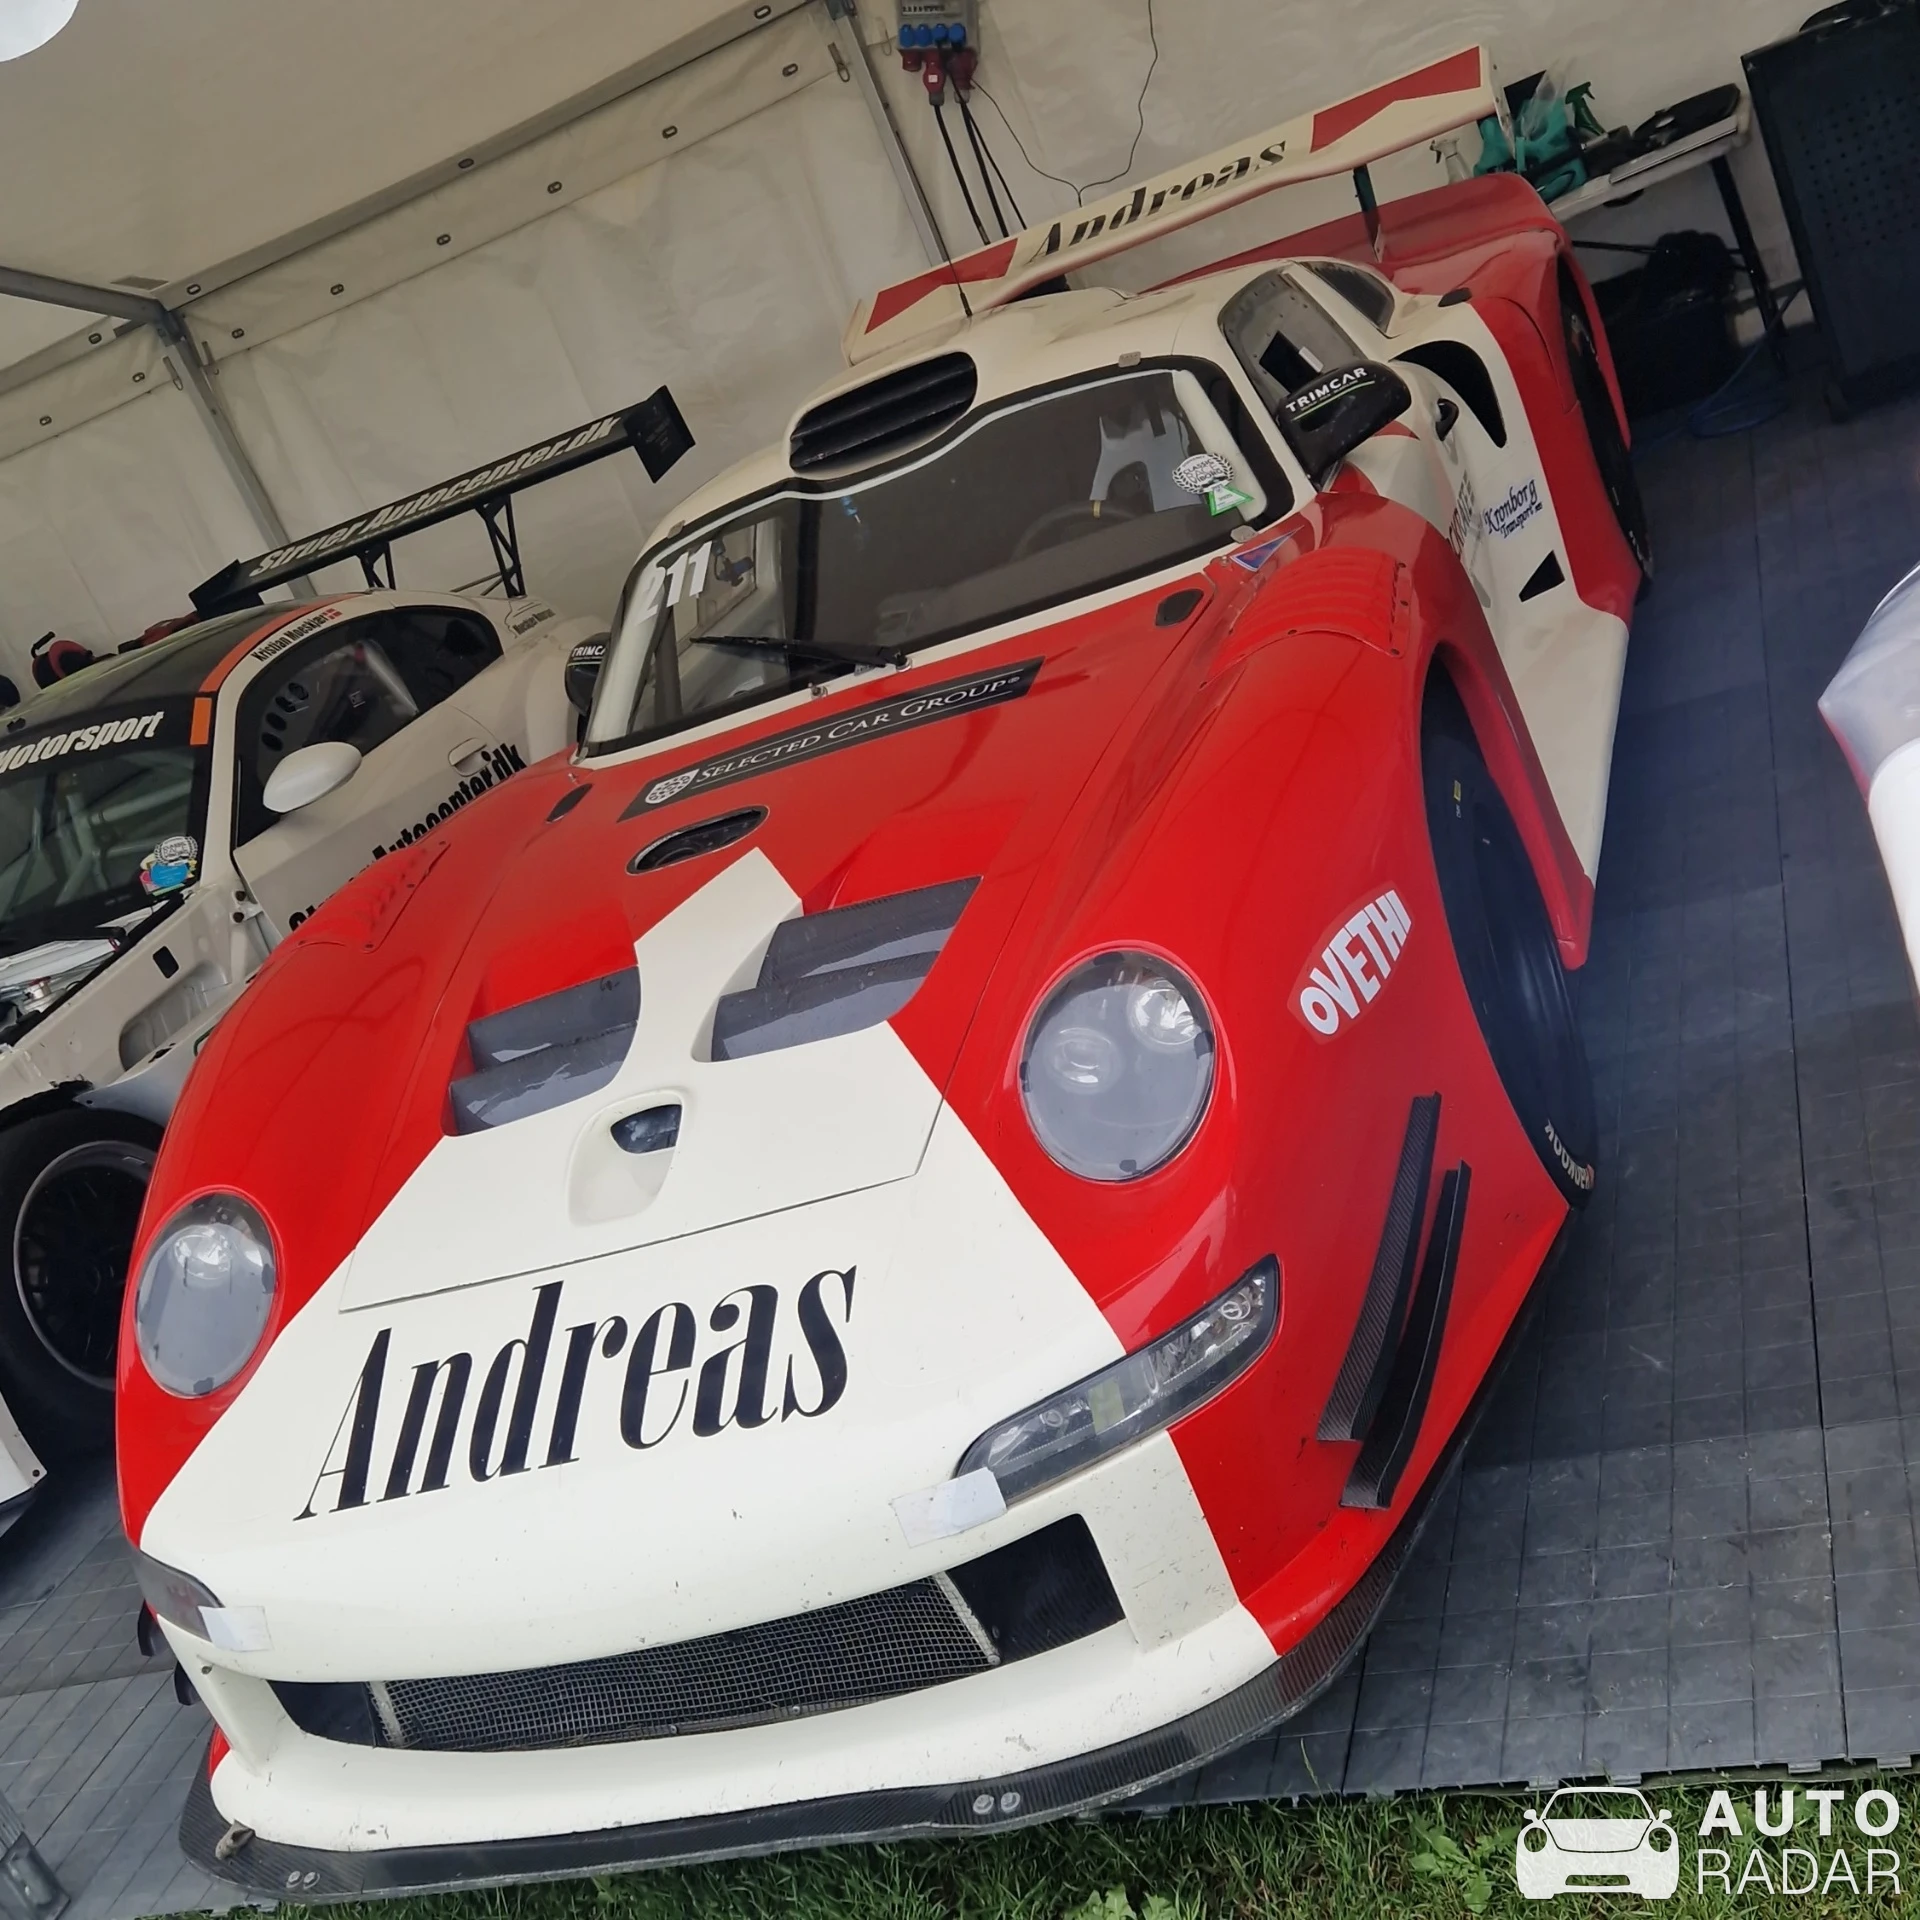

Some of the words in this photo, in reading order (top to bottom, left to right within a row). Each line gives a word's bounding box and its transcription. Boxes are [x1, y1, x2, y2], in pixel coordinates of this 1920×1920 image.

[1026, 141, 1286, 265] Andreas
[1285, 367, 1368, 412] TRIMCAR
[249, 520, 369, 577] Struer
[362, 415, 622, 532] Autocenter.dk
[1183, 459, 1214, 475] CLASSIC
[1483, 479, 1538, 534] Kronborg
[634, 541, 712, 625] 211
[251, 636, 292, 662] Kristian
[696, 734, 820, 783] SELECTED
[828, 713, 890, 739] CAR
[1300, 889, 1412, 1035] OVETHI
[293, 1265, 857, 1522] Andreas
